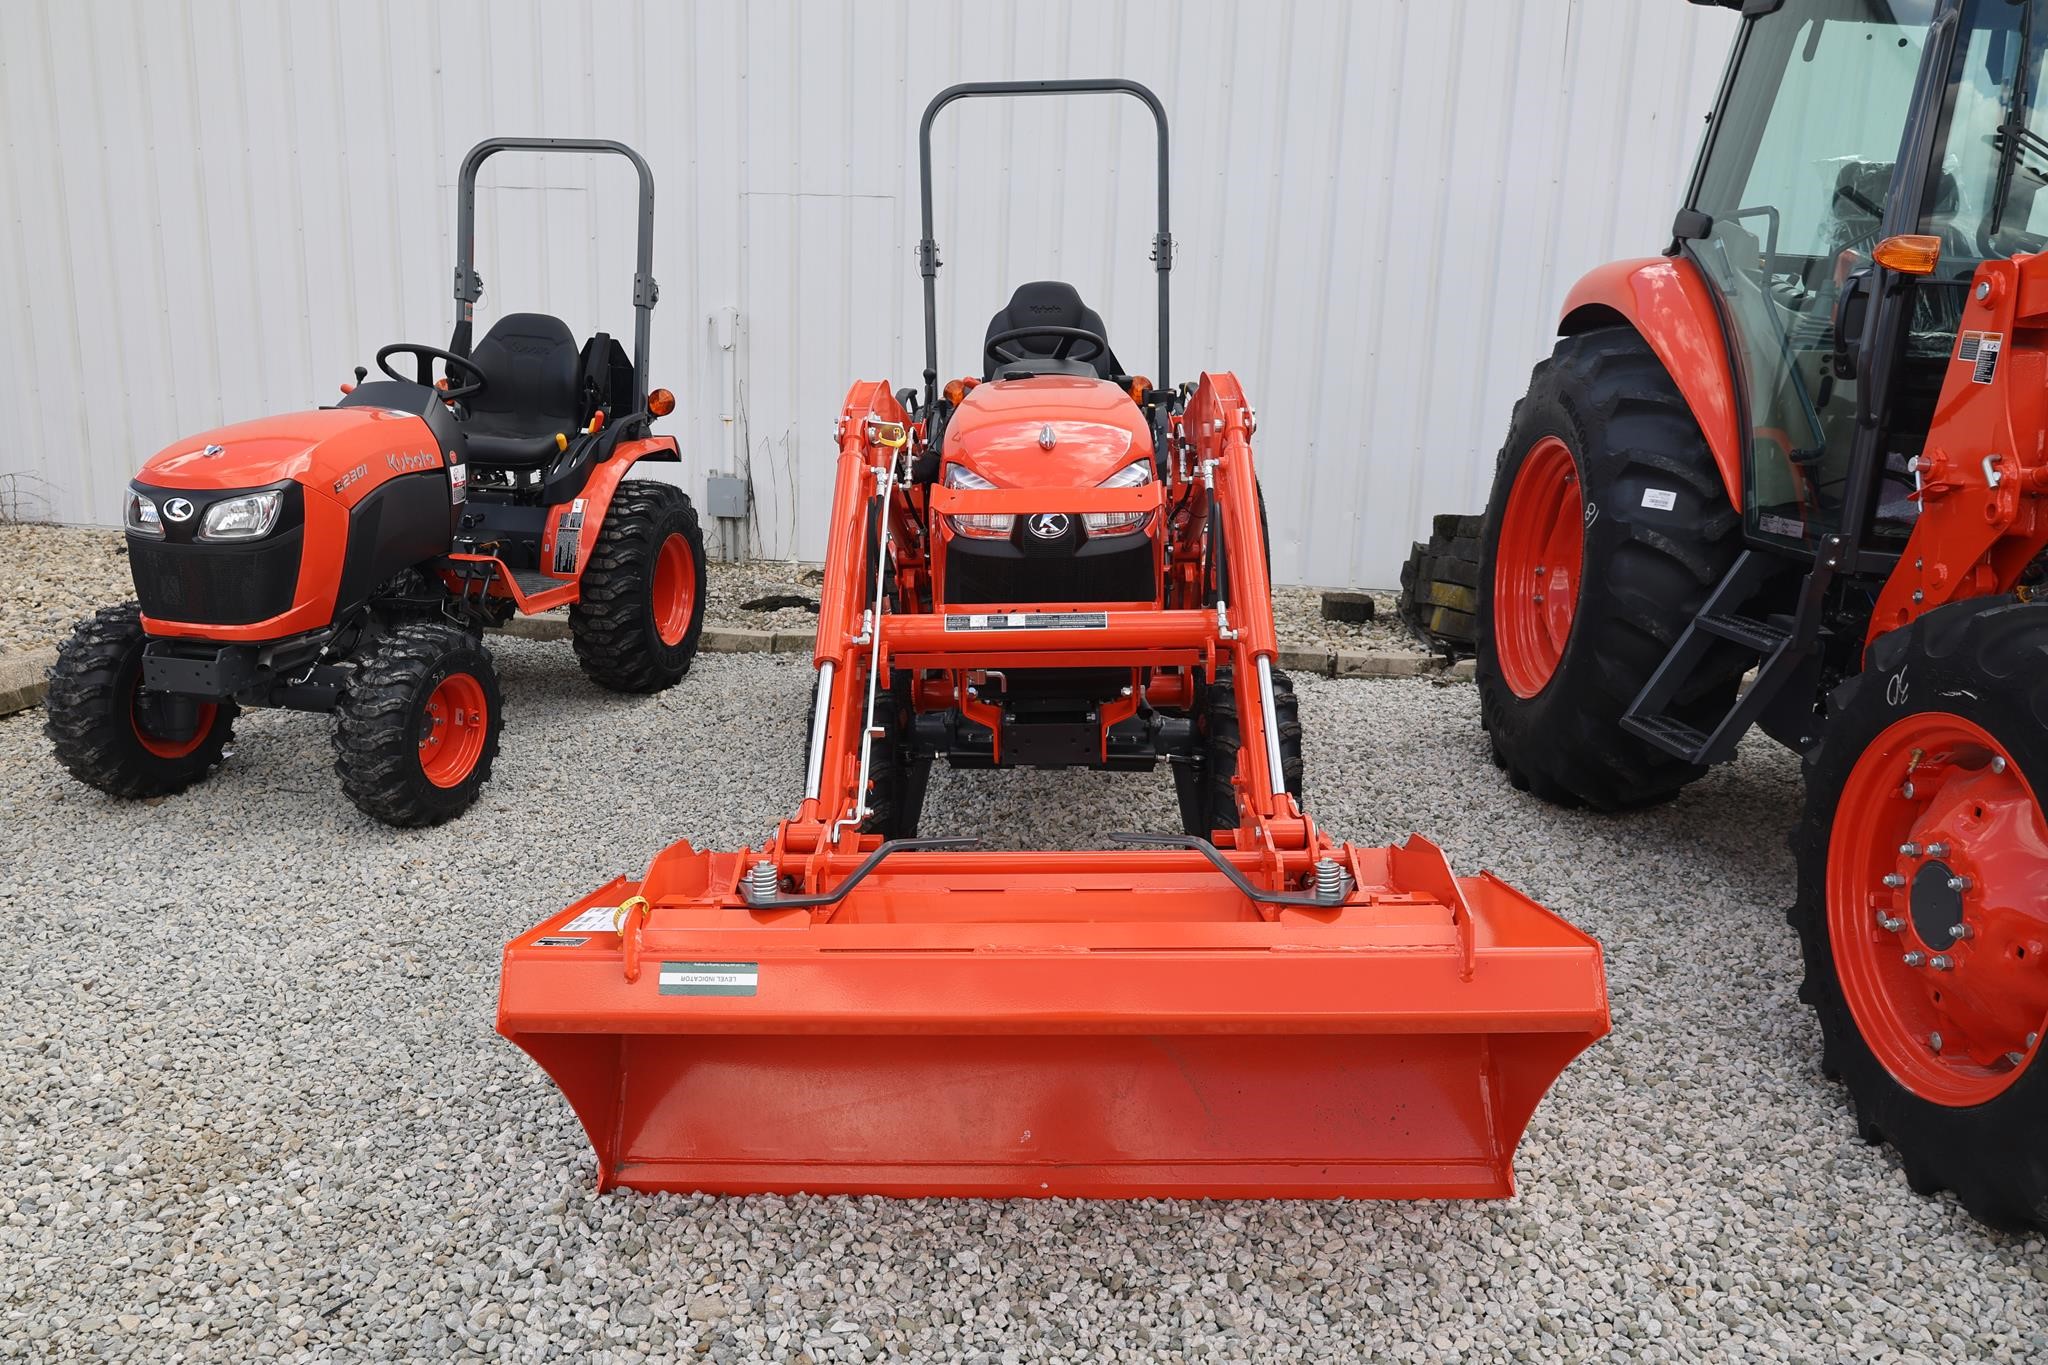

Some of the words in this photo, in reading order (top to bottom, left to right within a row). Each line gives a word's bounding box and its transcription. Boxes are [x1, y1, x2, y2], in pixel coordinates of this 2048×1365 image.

[385, 449, 436, 473] Kubota
[680, 975, 716, 983] INDICATOR
[717, 975, 737, 983] LEVEL
